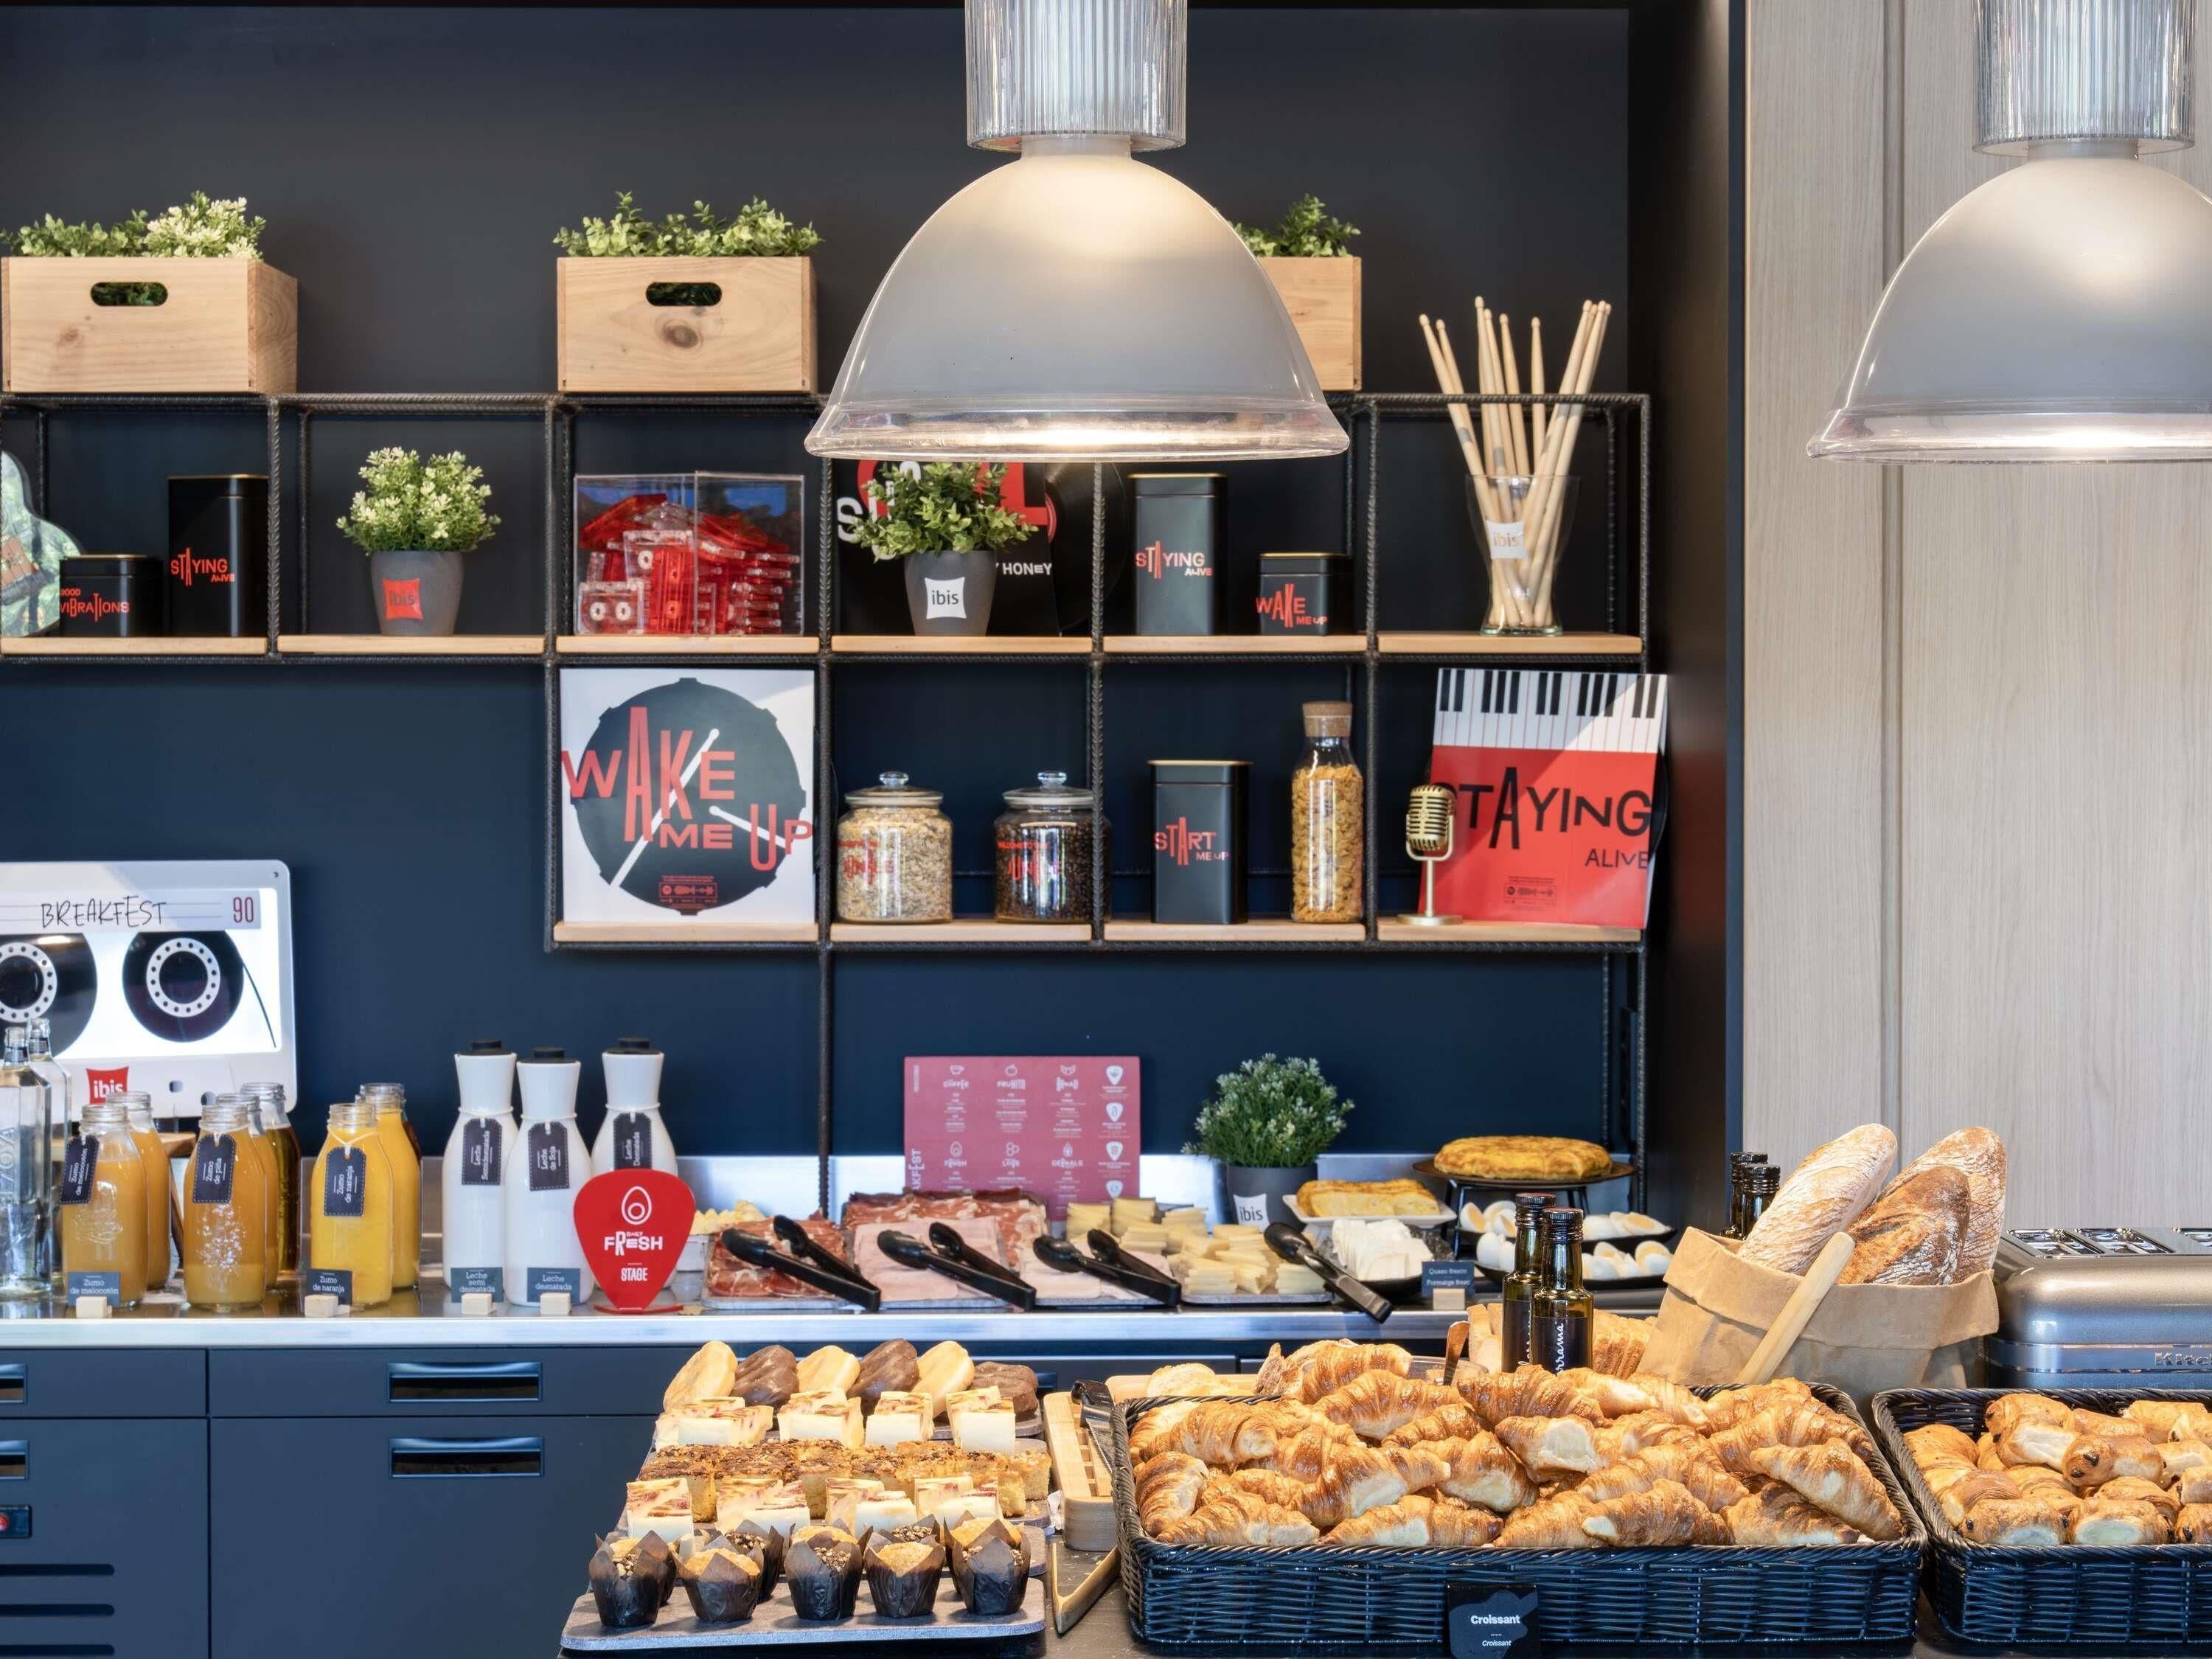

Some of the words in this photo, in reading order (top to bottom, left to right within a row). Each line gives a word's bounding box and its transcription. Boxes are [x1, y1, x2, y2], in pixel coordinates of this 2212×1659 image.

[170, 547, 229, 587] STAYING
[1135, 540, 1206, 579] STAYING
[1003, 563, 1052, 576] HONEY
[1184, 568, 1214, 577] ALIVE
[389, 589, 415, 606] ibis
[931, 590, 959, 605] ibis
[1256, 583, 1307, 628] WAKE
[60, 593, 130, 622] VIBRATIONS
[1296, 616, 1312, 625] ME
[561, 706, 736, 842] WAKE
[660, 824, 733, 849] ME
[750, 803, 813, 872] UP
[1153, 816, 1217, 866] START
[1196, 852, 1212, 861] ME
[1585, 849, 1649, 869] ALIVE
[41, 895, 167, 928] BREAKFEST
[232, 896, 254, 923] 90
[93, 1079, 124, 1099] ibis
[71, 1162, 80, 1183] Zumo
[206, 1161, 214, 1181] Zumo
[549, 1161, 557, 1171] de
[213, 1174, 220, 1185] de
[336, 1173, 344, 1194] Zumo
[344, 1193, 352, 1203] de
[1239, 1206, 1263, 1221] ibis
[604, 1231, 664, 1256] FRESH
[83, 1279, 105, 1287] Zumo
[621, 1267, 648, 1281] STAGE
[313, 1283, 321, 1291] de
[2154, 1352, 2212, 1366] Kitc
[1470, 1613, 1520, 1624] Croissant
